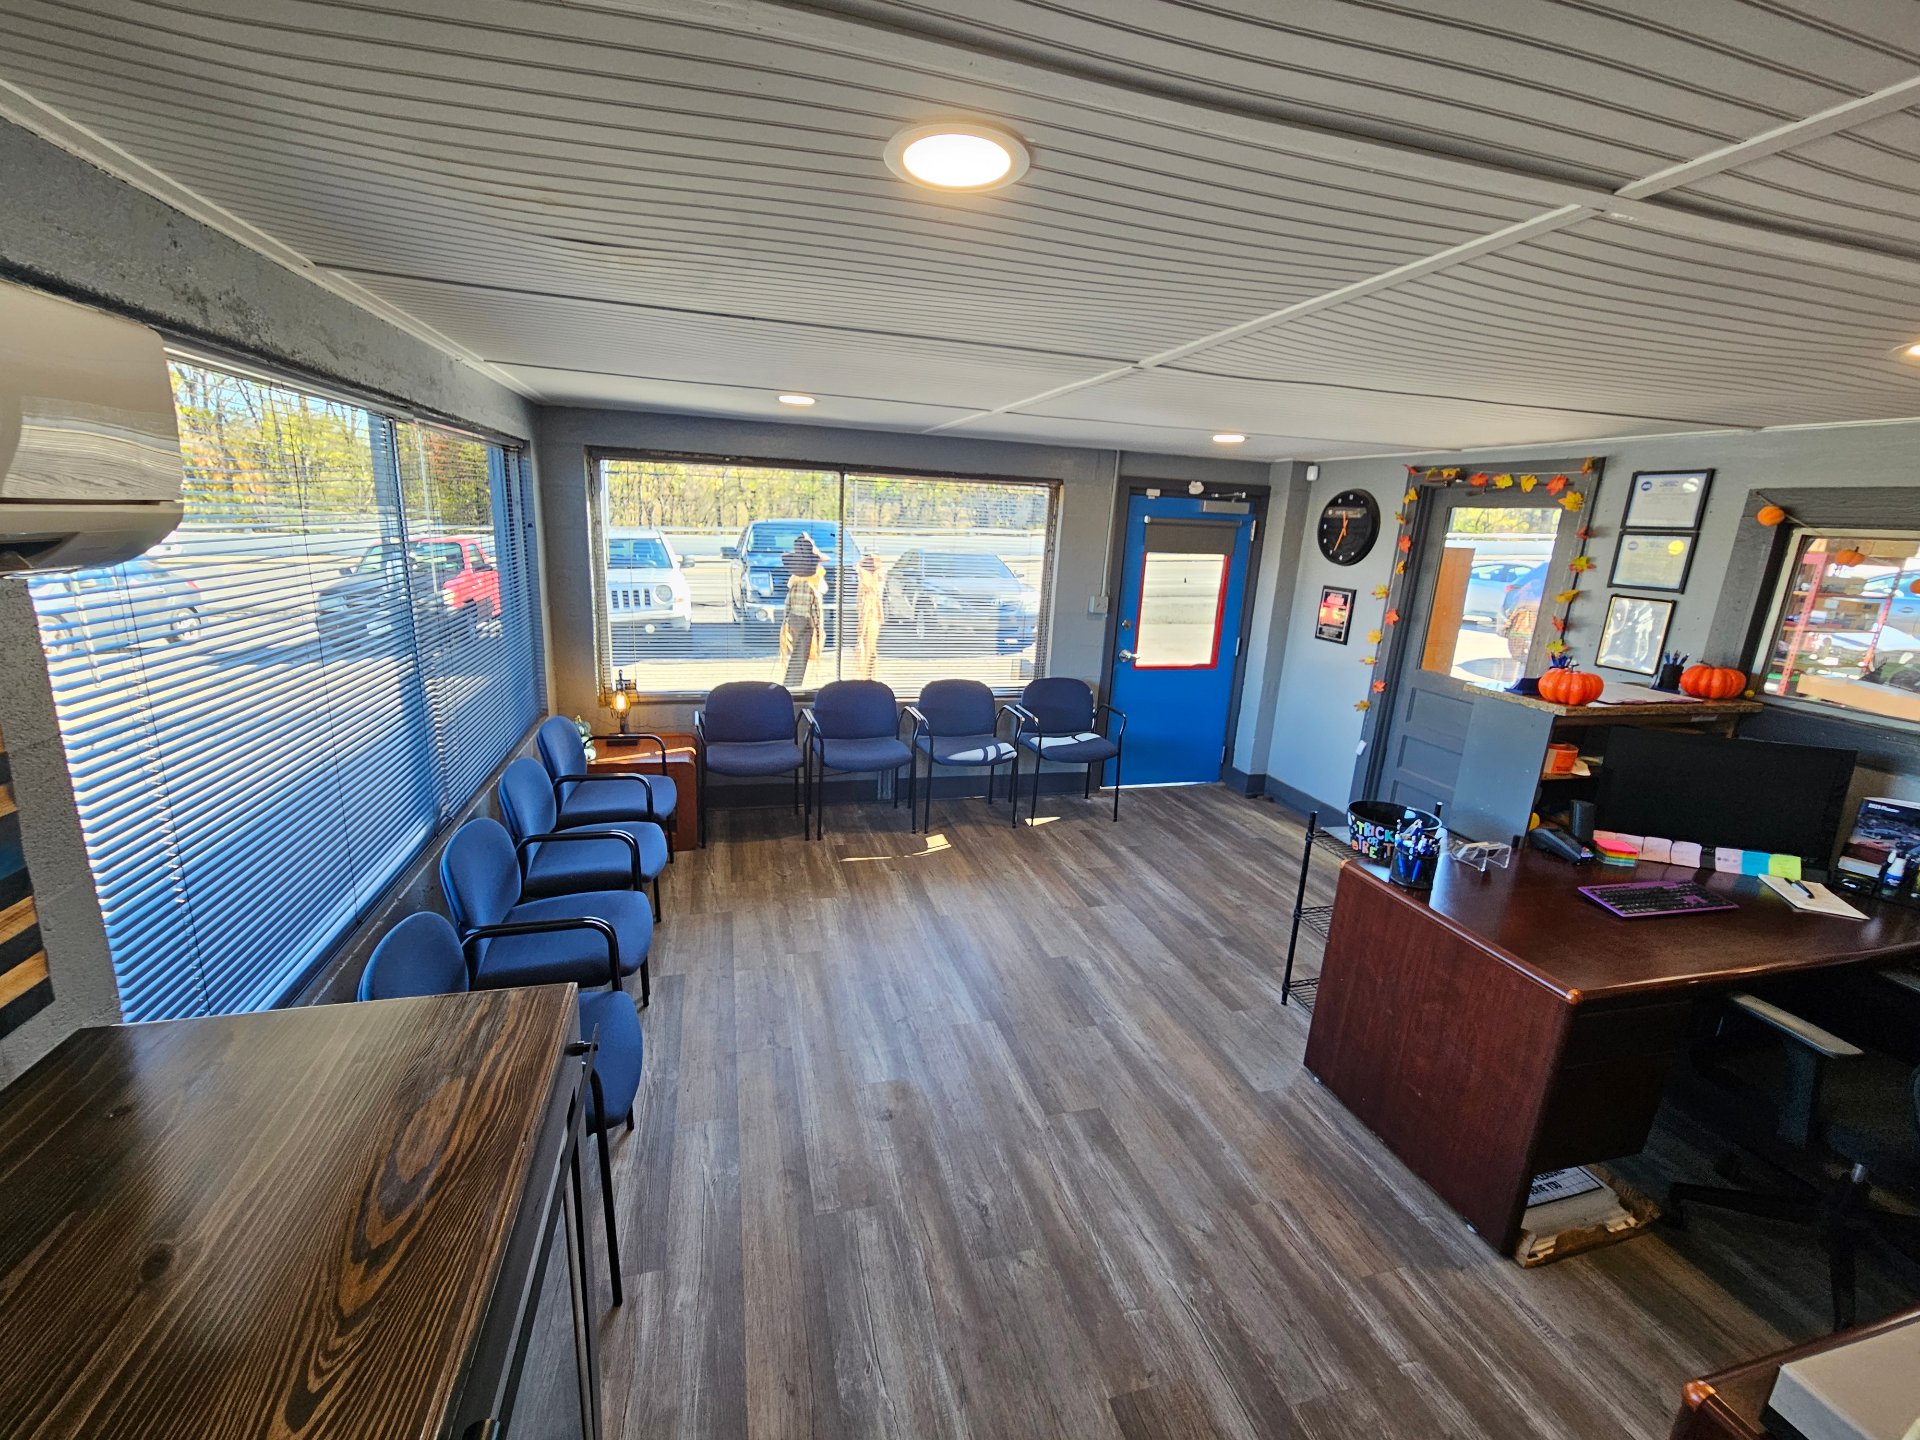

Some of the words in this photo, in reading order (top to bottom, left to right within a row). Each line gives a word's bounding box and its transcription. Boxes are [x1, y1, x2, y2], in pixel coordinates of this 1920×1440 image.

[1356, 820, 1395, 842] TRICK
[1356, 833, 1394, 859] TRET
[1367, 836, 1379, 849] OR
